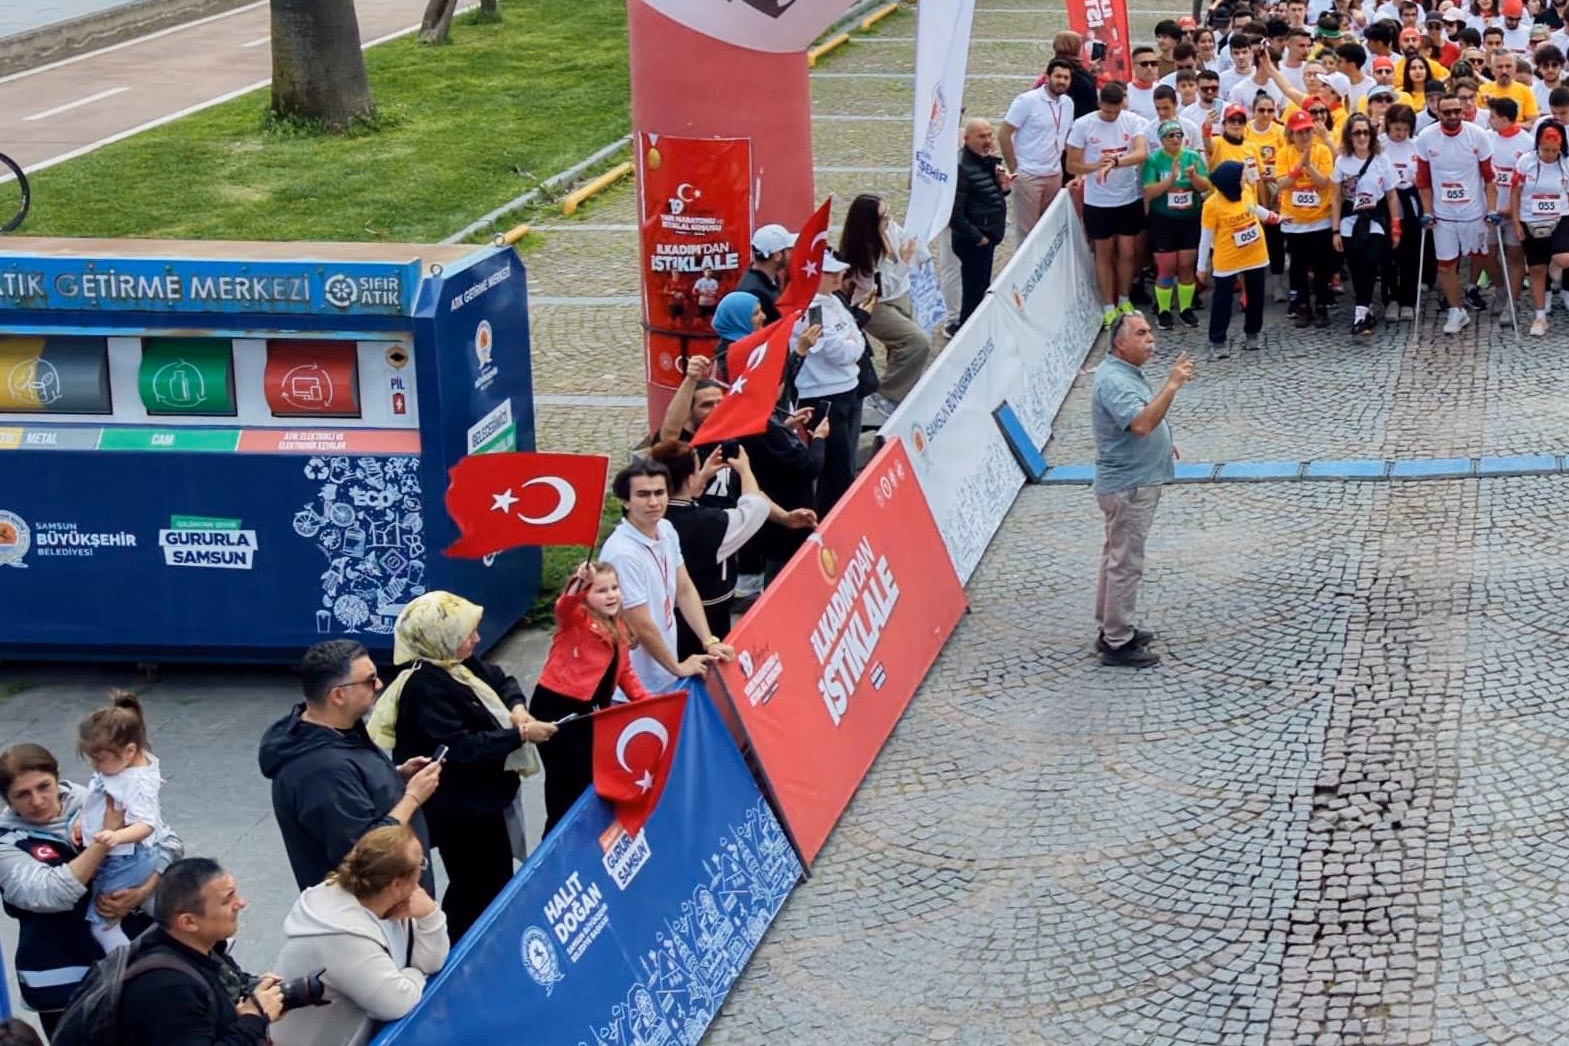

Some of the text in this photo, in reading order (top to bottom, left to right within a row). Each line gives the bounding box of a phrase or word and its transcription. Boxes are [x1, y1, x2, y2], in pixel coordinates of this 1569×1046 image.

[1296, 194, 1316, 205] 055
[1446, 189, 1466, 200] 055
[0, 268, 310, 301] TIK GETİRME MERKEZİ
[359, 276, 400, 291] SIFIR
[360, 290, 400, 306] ATIK
[390, 376, 406, 390] PİL
[25, 432, 58, 445] METAL
[151, 433, 176, 446] CAM
[353, 490, 394, 507] ECO
[35, 521, 78, 531] SAMSUN
[36, 530, 138, 548] BÜYÜKŞEHİR
[165, 532, 251, 547] GURURLA
[37, 546, 94, 557] BELEDİYESİ
[172, 550, 248, 565] SAMSUN
